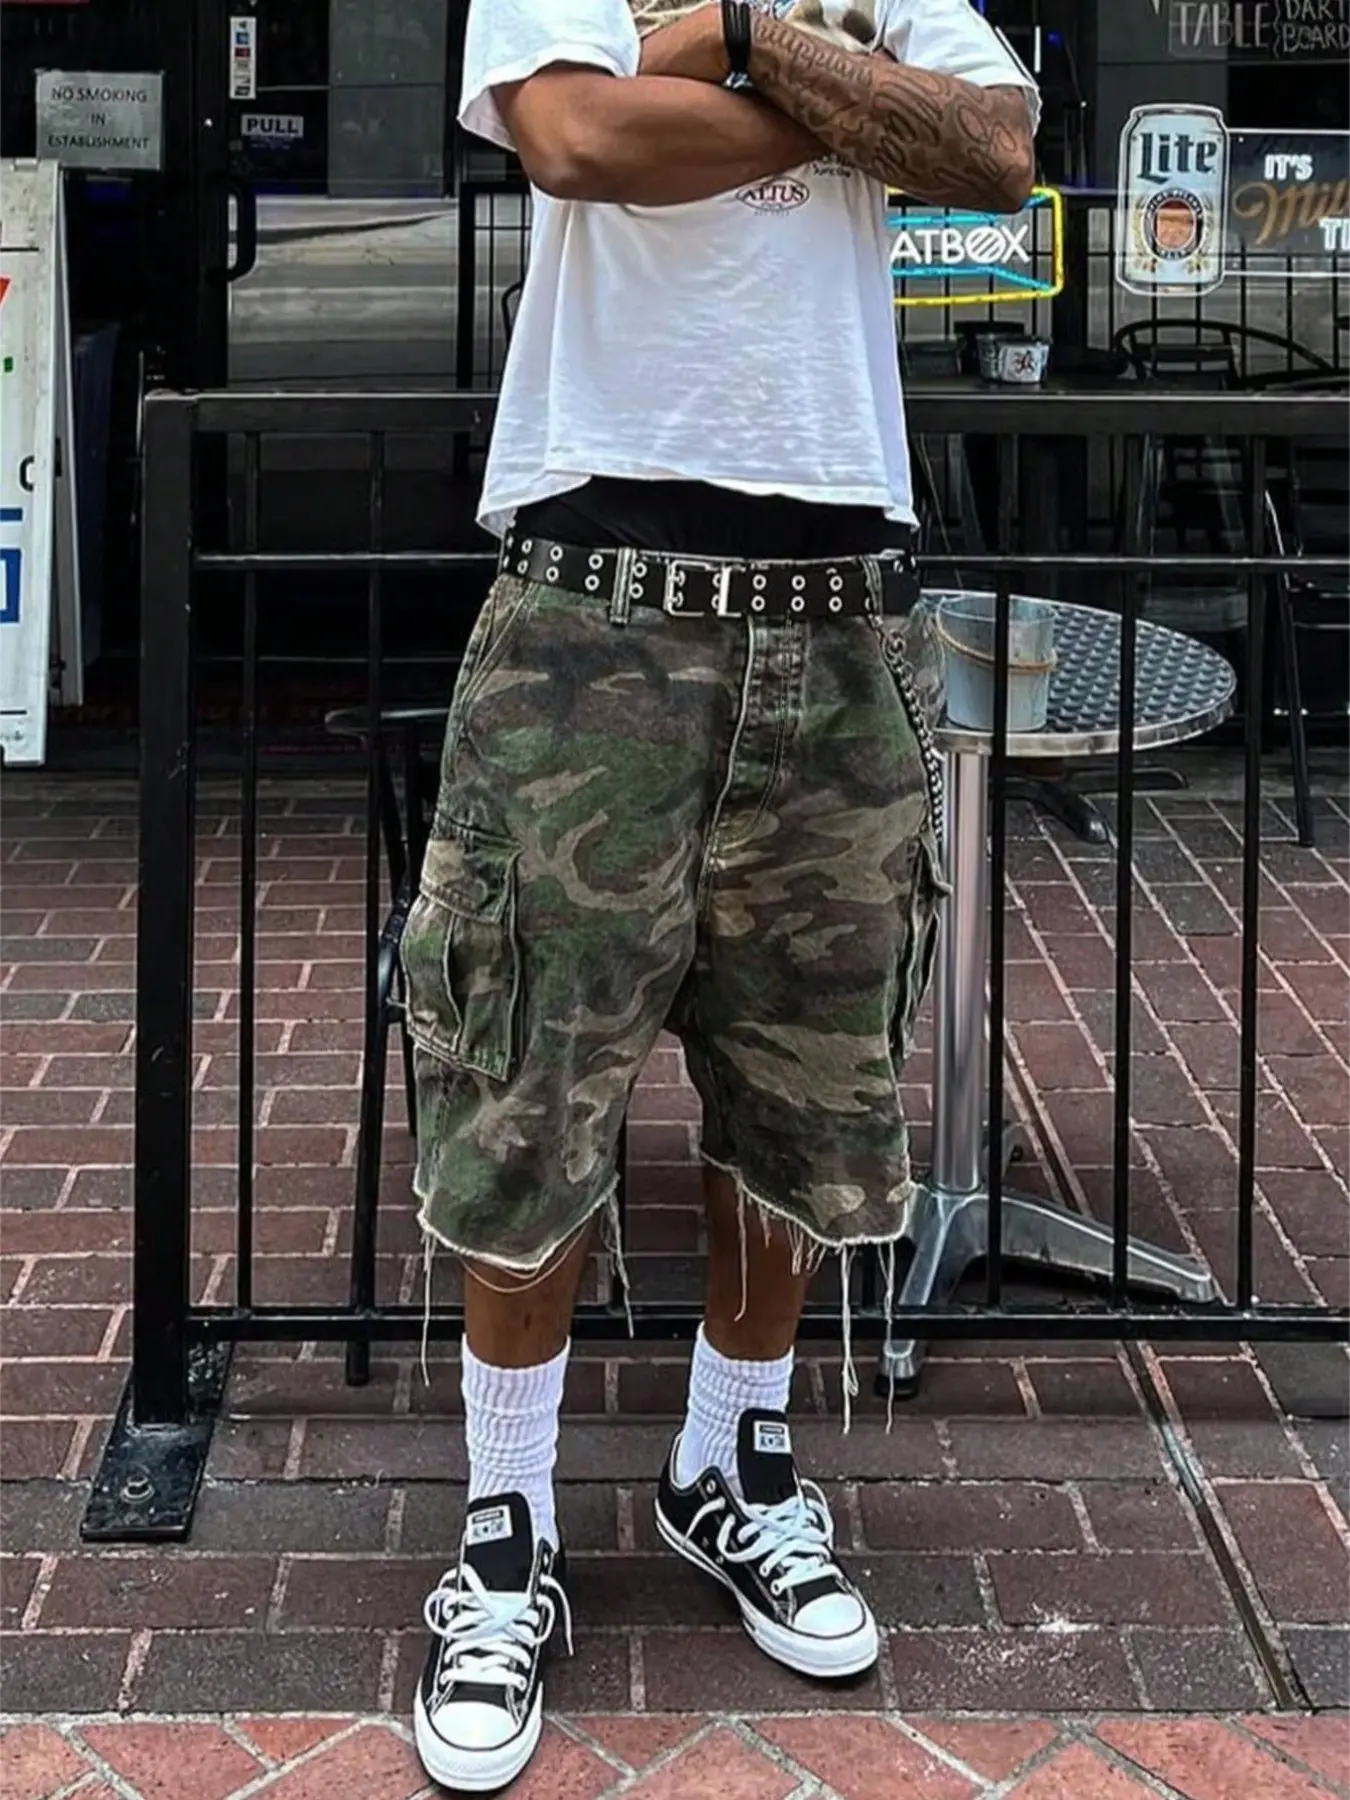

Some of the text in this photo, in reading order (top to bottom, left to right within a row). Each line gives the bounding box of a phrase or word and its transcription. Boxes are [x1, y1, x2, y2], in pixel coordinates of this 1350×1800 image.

[1173, 2, 1270, 48] TABLE
[1282, 22, 1350, 52] BOARD
[52, 86, 148, 103] NO SMOKING
[91, 112, 106, 126] IN
[246, 118, 299, 135] PULL
[48, 133, 149, 149] ESTABLISHMENT
[1137, 131, 1219, 184] Lite
[1264, 153, 1314, 180] IT'S
